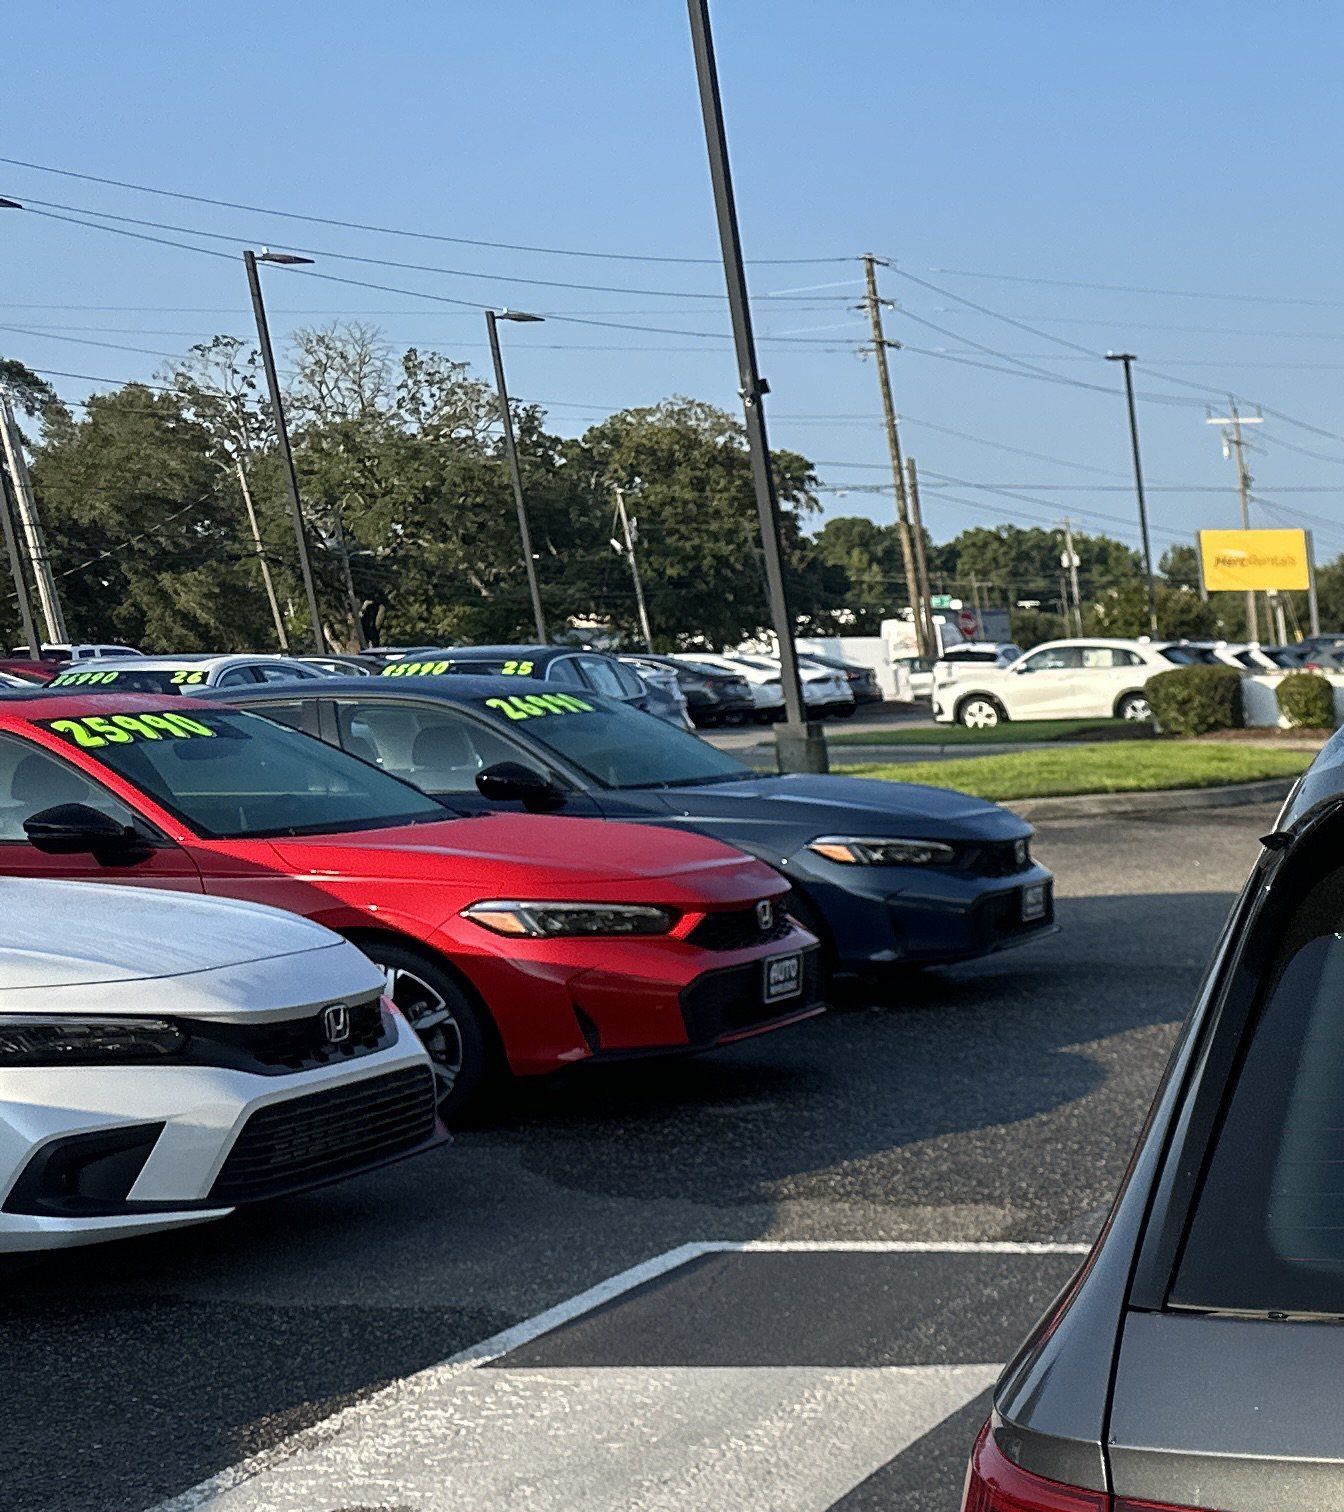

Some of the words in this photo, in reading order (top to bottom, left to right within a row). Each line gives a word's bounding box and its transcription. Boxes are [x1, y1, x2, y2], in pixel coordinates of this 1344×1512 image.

[501, 661, 534, 675] 25
[170, 671, 203, 684] 26
[50, 712, 217, 748] 25990
